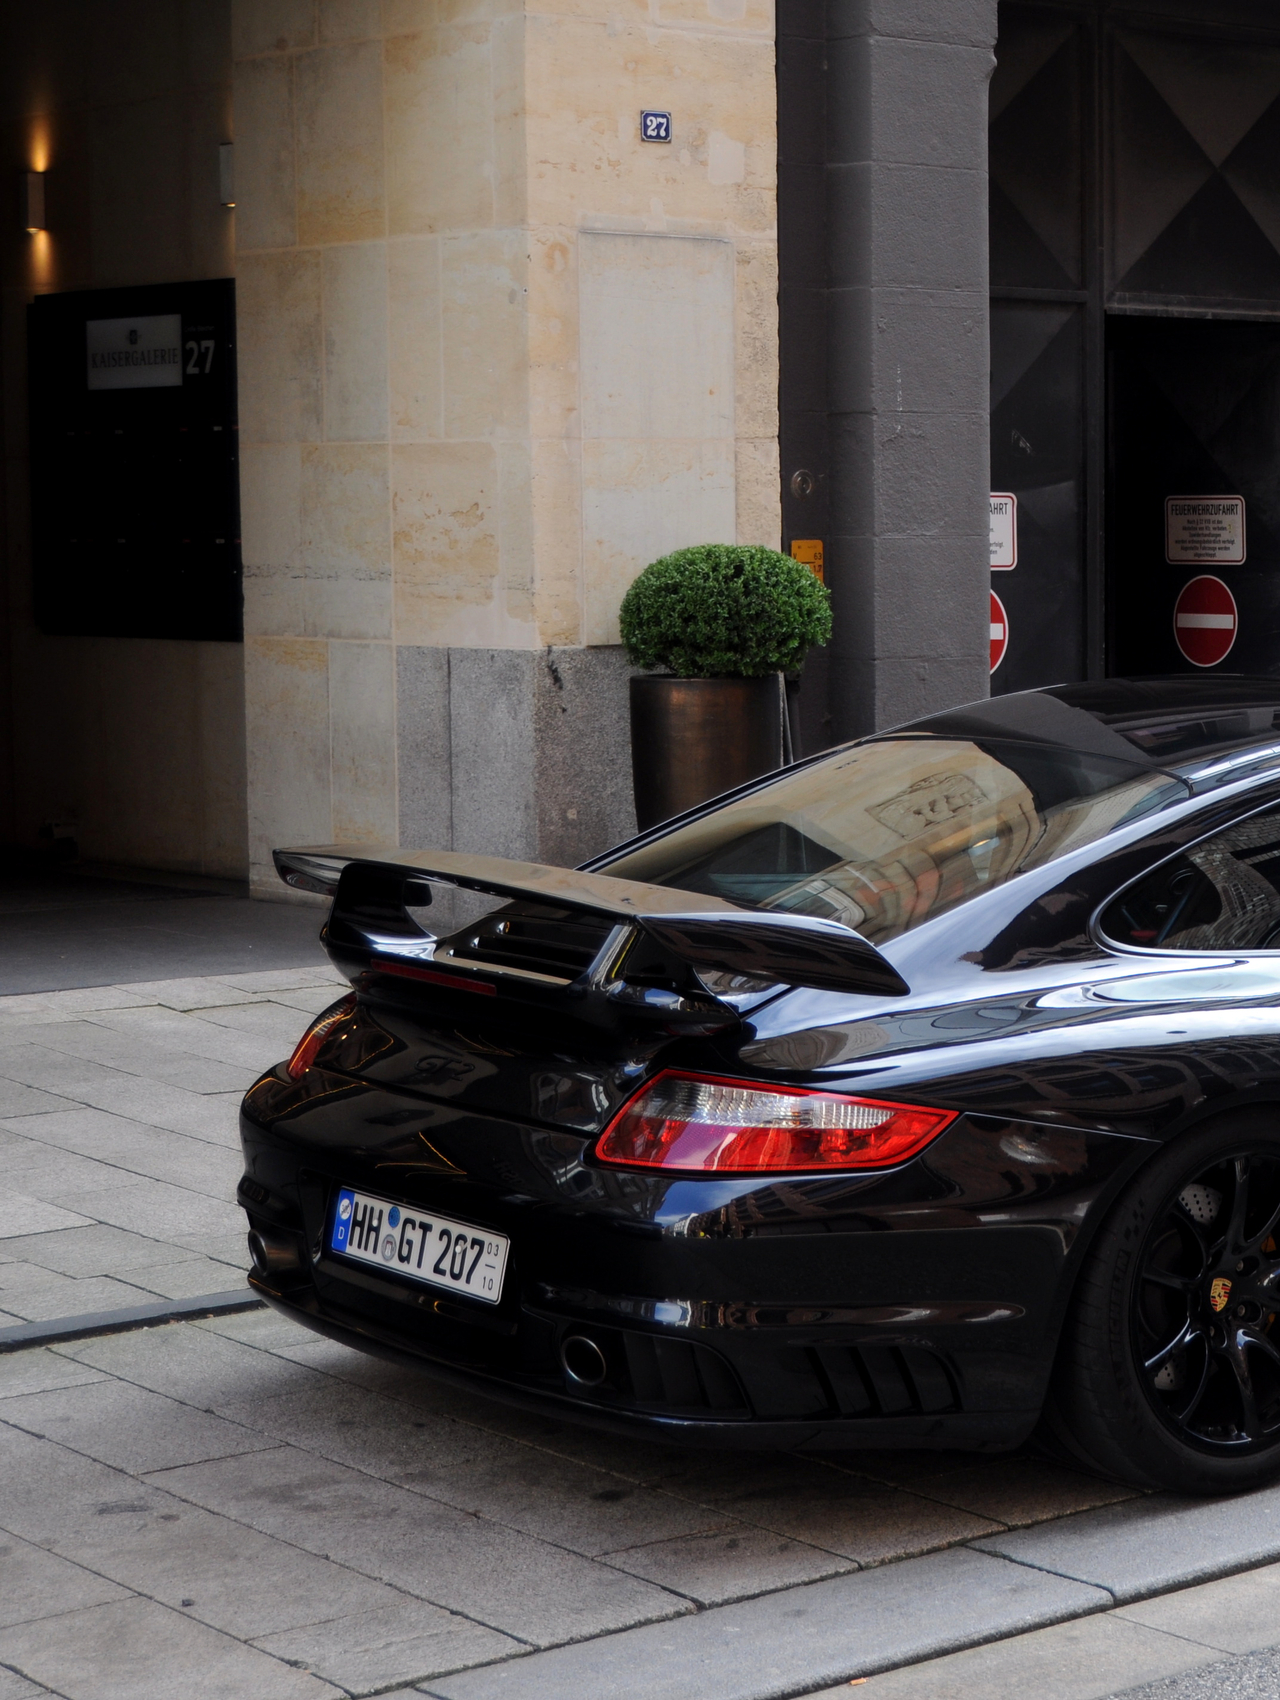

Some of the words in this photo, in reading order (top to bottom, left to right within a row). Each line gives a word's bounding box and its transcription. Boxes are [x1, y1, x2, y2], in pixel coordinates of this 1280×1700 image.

[646, 116, 667, 137] 27
[91, 348, 179, 369] KAISERGALERIE
[185, 340, 215, 374] 27
[1171, 503, 1239, 516] FEUERWEHRZUFAHRT
[337, 1227, 345, 1240] D
[349, 1201, 384, 1255] HH
[397, 1217, 433, 1269] GT
[433, 1228, 485, 1285] 207
[487, 1242, 500, 1257] 03
[482, 1275, 494, 1291] 10
